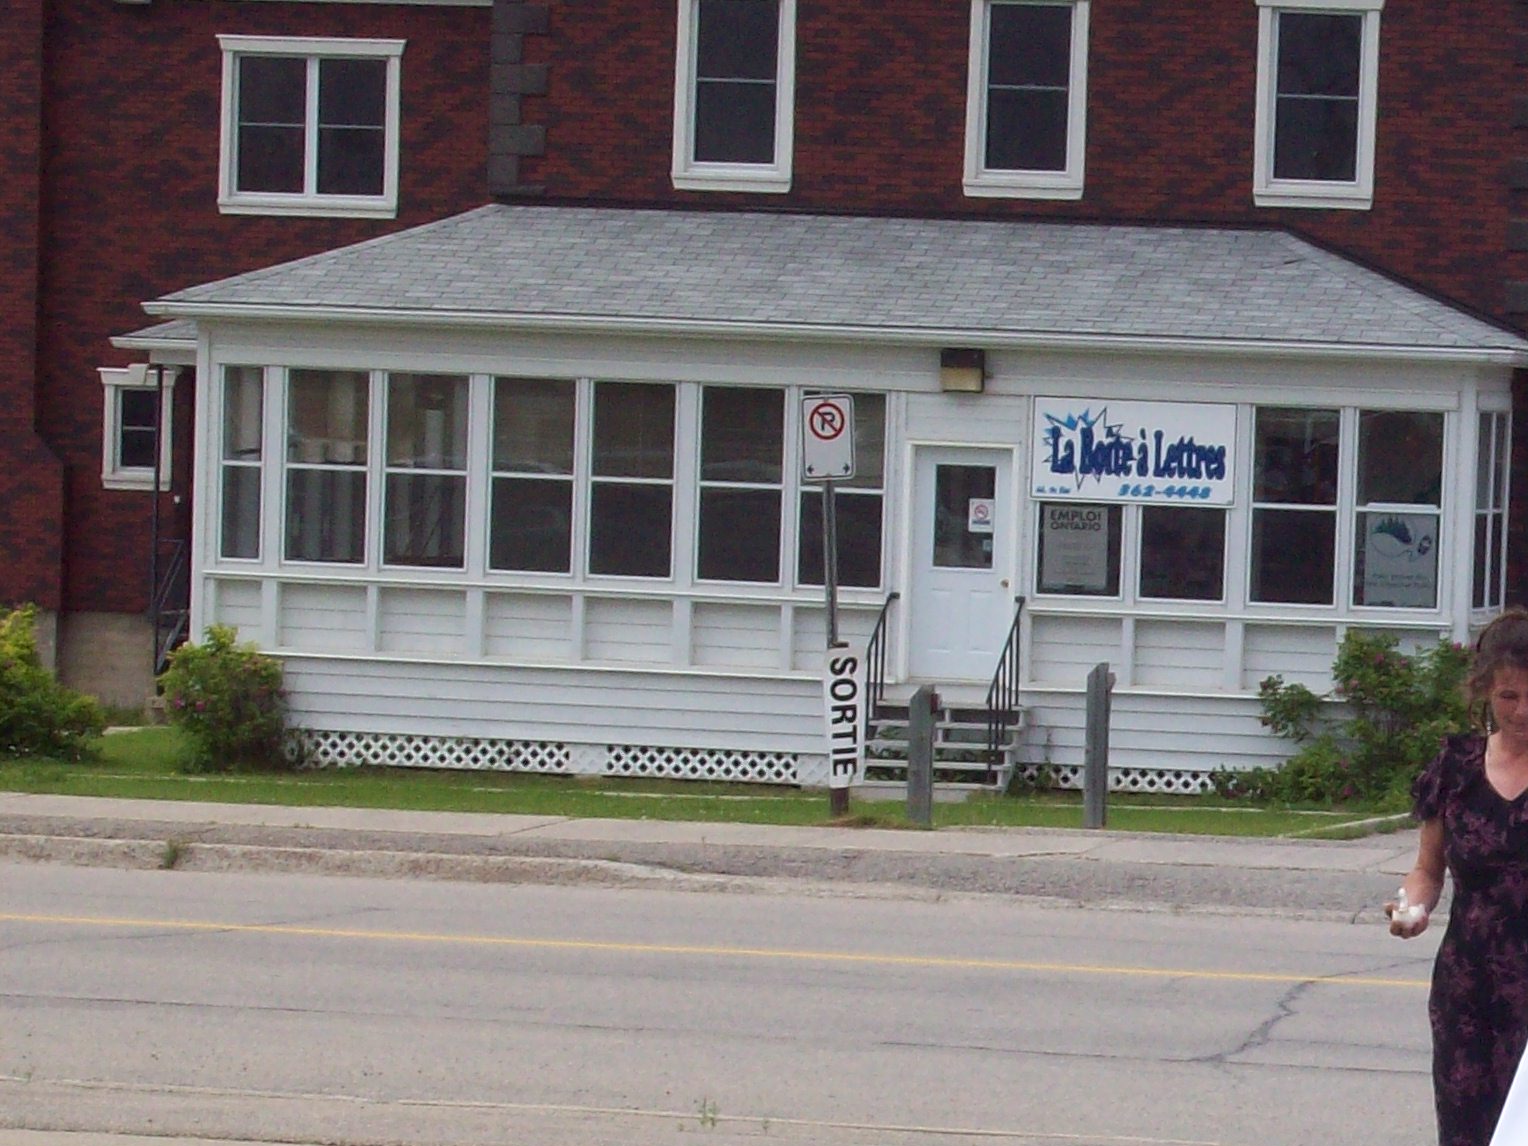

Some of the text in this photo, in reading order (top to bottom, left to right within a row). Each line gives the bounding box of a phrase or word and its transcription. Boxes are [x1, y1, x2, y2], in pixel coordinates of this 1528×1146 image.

[1050, 425, 1075, 474] La
[1136, 427, 1149, 477] à
[1153, 430, 1227, 480] Lettres
[1050, 521, 1101, 531] ONTARIO
[829, 657, 858, 776] SORTIE
